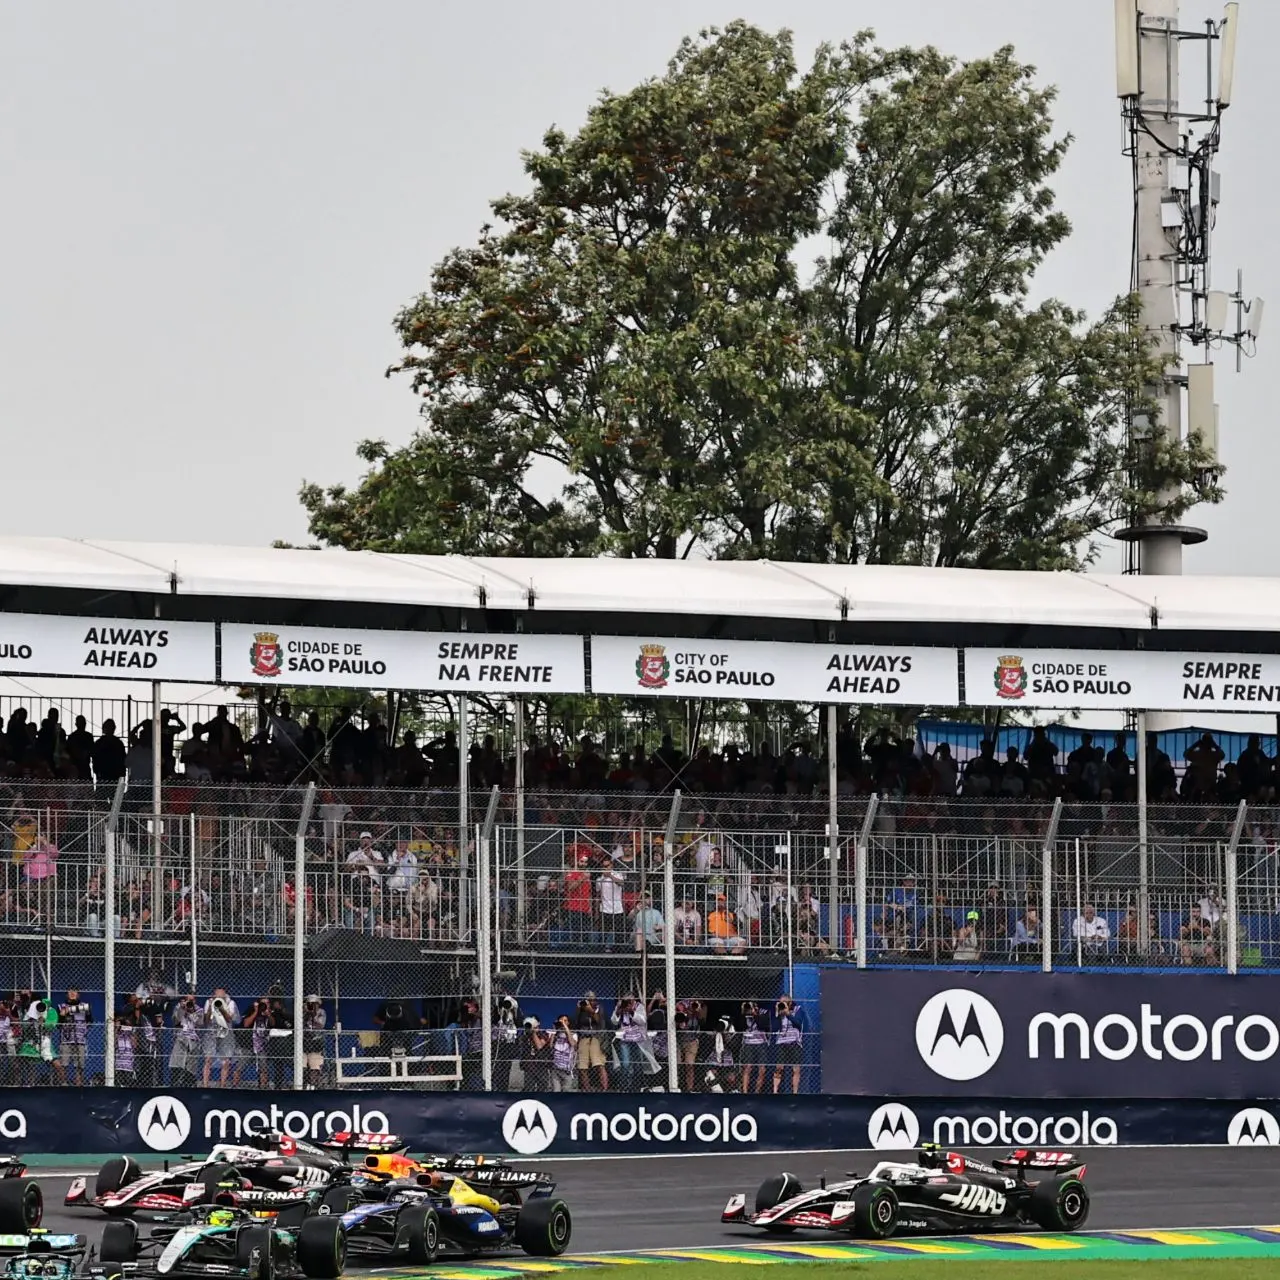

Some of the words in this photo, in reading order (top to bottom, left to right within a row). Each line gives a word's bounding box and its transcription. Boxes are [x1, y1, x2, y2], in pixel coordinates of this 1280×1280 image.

[84, 628, 168, 647] ALWAYS
[288, 641, 339, 655] CIDADE
[344, 644, 362, 655] DE
[438, 642, 518, 660] SEMPRE
[84, 650, 157, 668] AHEAD
[289, 655, 324, 672] SÃO
[329, 659, 386, 674] PAULO
[675, 653, 705, 666] CITY
[710, 655, 728, 666] OF
[827, 654, 911, 672] ALWAYS
[439, 664, 470, 680] NA
[479, 666, 552, 682] FRENTE
[675, 666, 711, 683] SÃO
[717, 671, 774, 686] PAULO
[1032, 664, 1083, 675] CIDADE
[1089, 665, 1106, 676] DE
[1183, 662, 1261, 679] SEMPRE
[827, 676, 900, 693] AHEAD
[1033, 676, 1069, 693] SÃO
[1074, 680, 1131, 694] PAULO
[1184, 684, 1214, 699] NA
[205, 1104, 389, 1139] motorola
[571, 1107, 757, 1141] motorola
[934, 1111, 1117, 1145] motorola
[477, 1171, 536, 1182] WILIAMS
